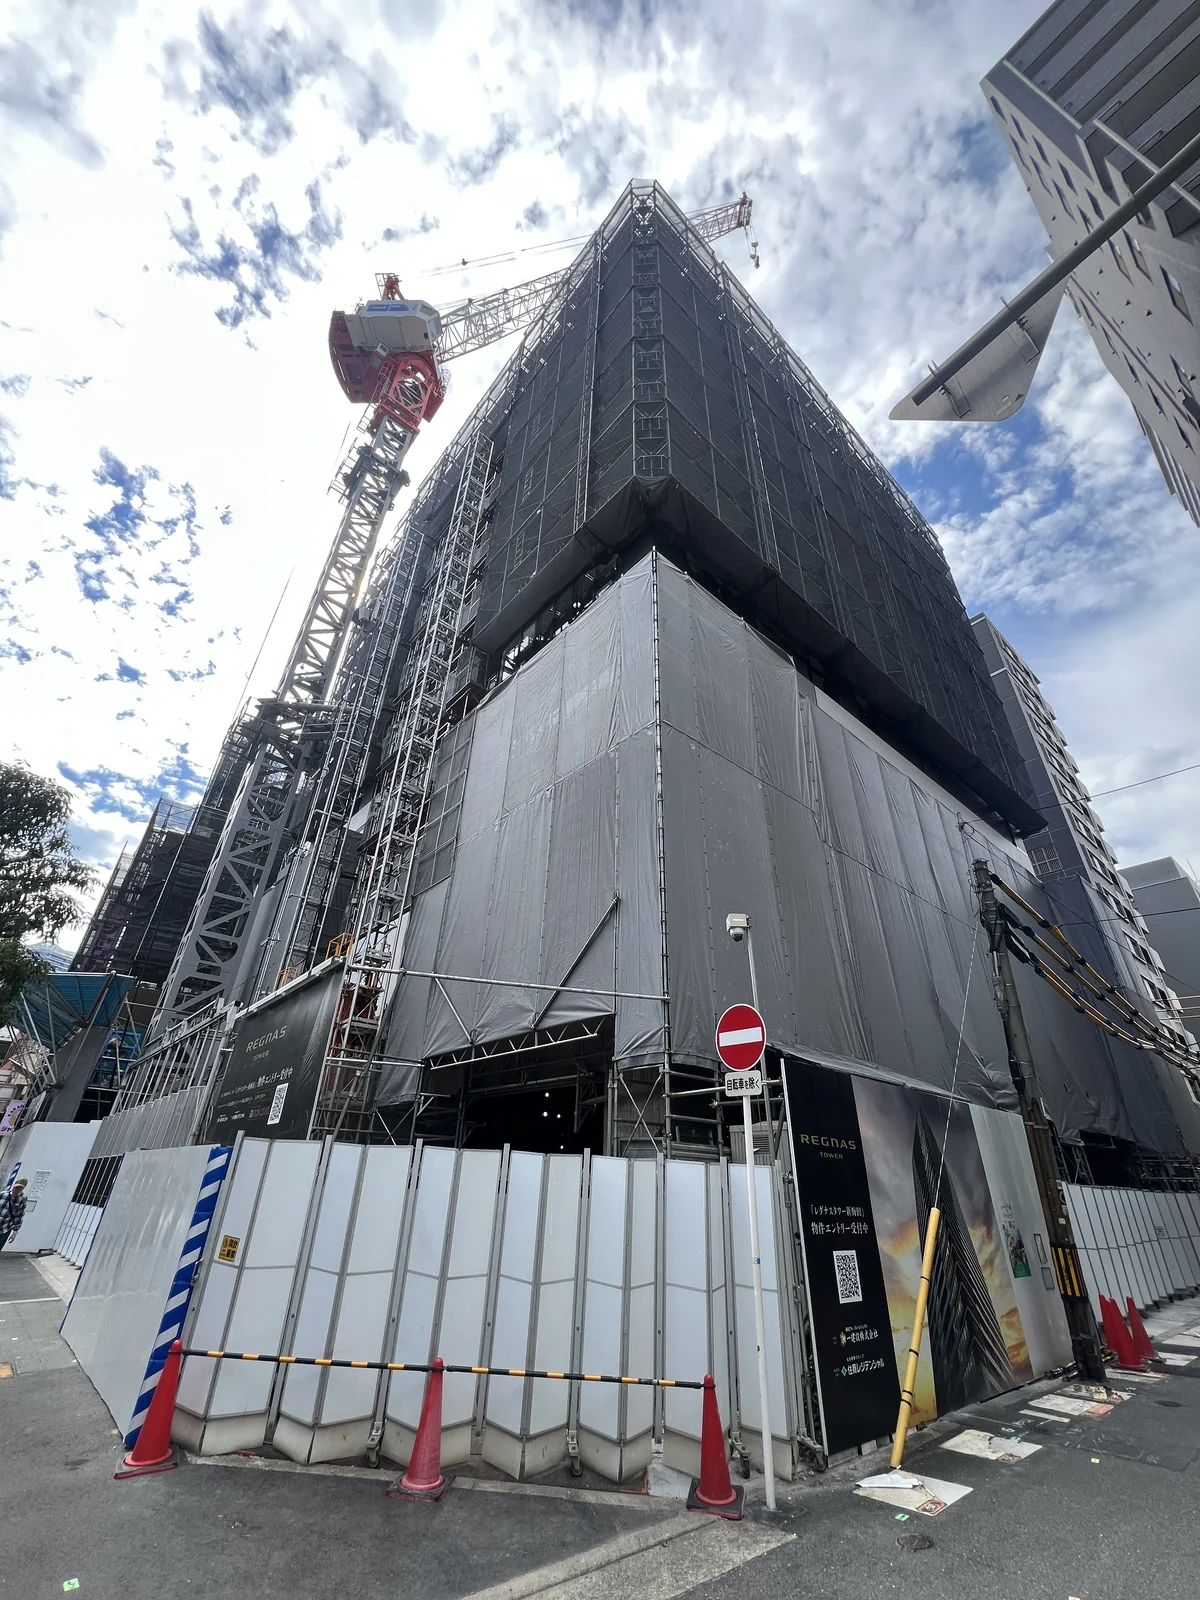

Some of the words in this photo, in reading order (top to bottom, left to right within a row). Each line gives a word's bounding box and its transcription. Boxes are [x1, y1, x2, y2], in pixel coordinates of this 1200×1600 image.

[246, 1025, 287, 1053] REGNAS
[726, 1077, 760, 1091] 自転車を除く
[800, 1134, 857, 1150] REGNAS
[819, 1151, 844, 1160] TOWER
[811, 1221, 869, 1235] 物件エントリー受付中
